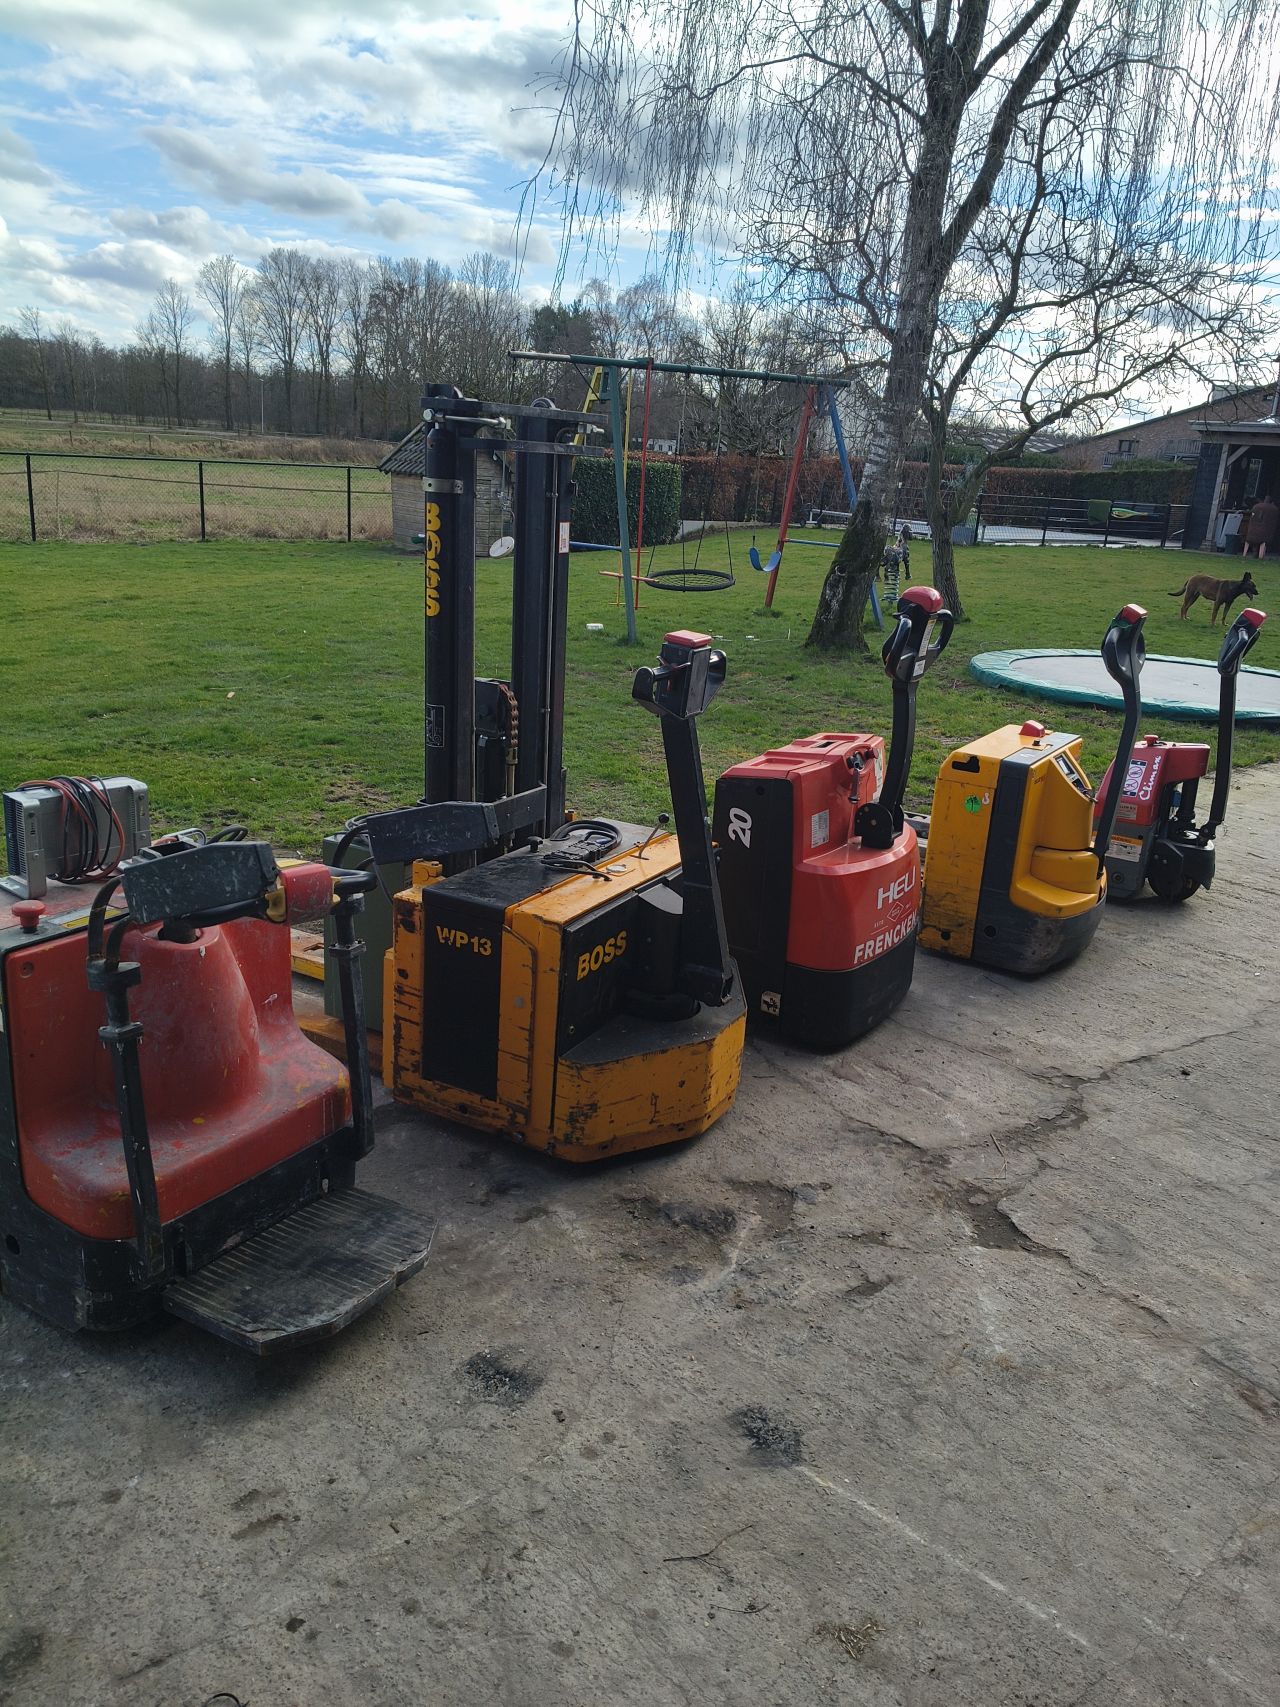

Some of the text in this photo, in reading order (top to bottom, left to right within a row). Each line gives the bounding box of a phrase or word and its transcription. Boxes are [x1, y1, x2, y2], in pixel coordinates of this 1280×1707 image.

[1139, 755, 1161, 801] Climax
[728, 807, 752, 849] 20
[576, 930, 628, 981] BOSS
[853, 908, 919, 964] FRENCKEN
